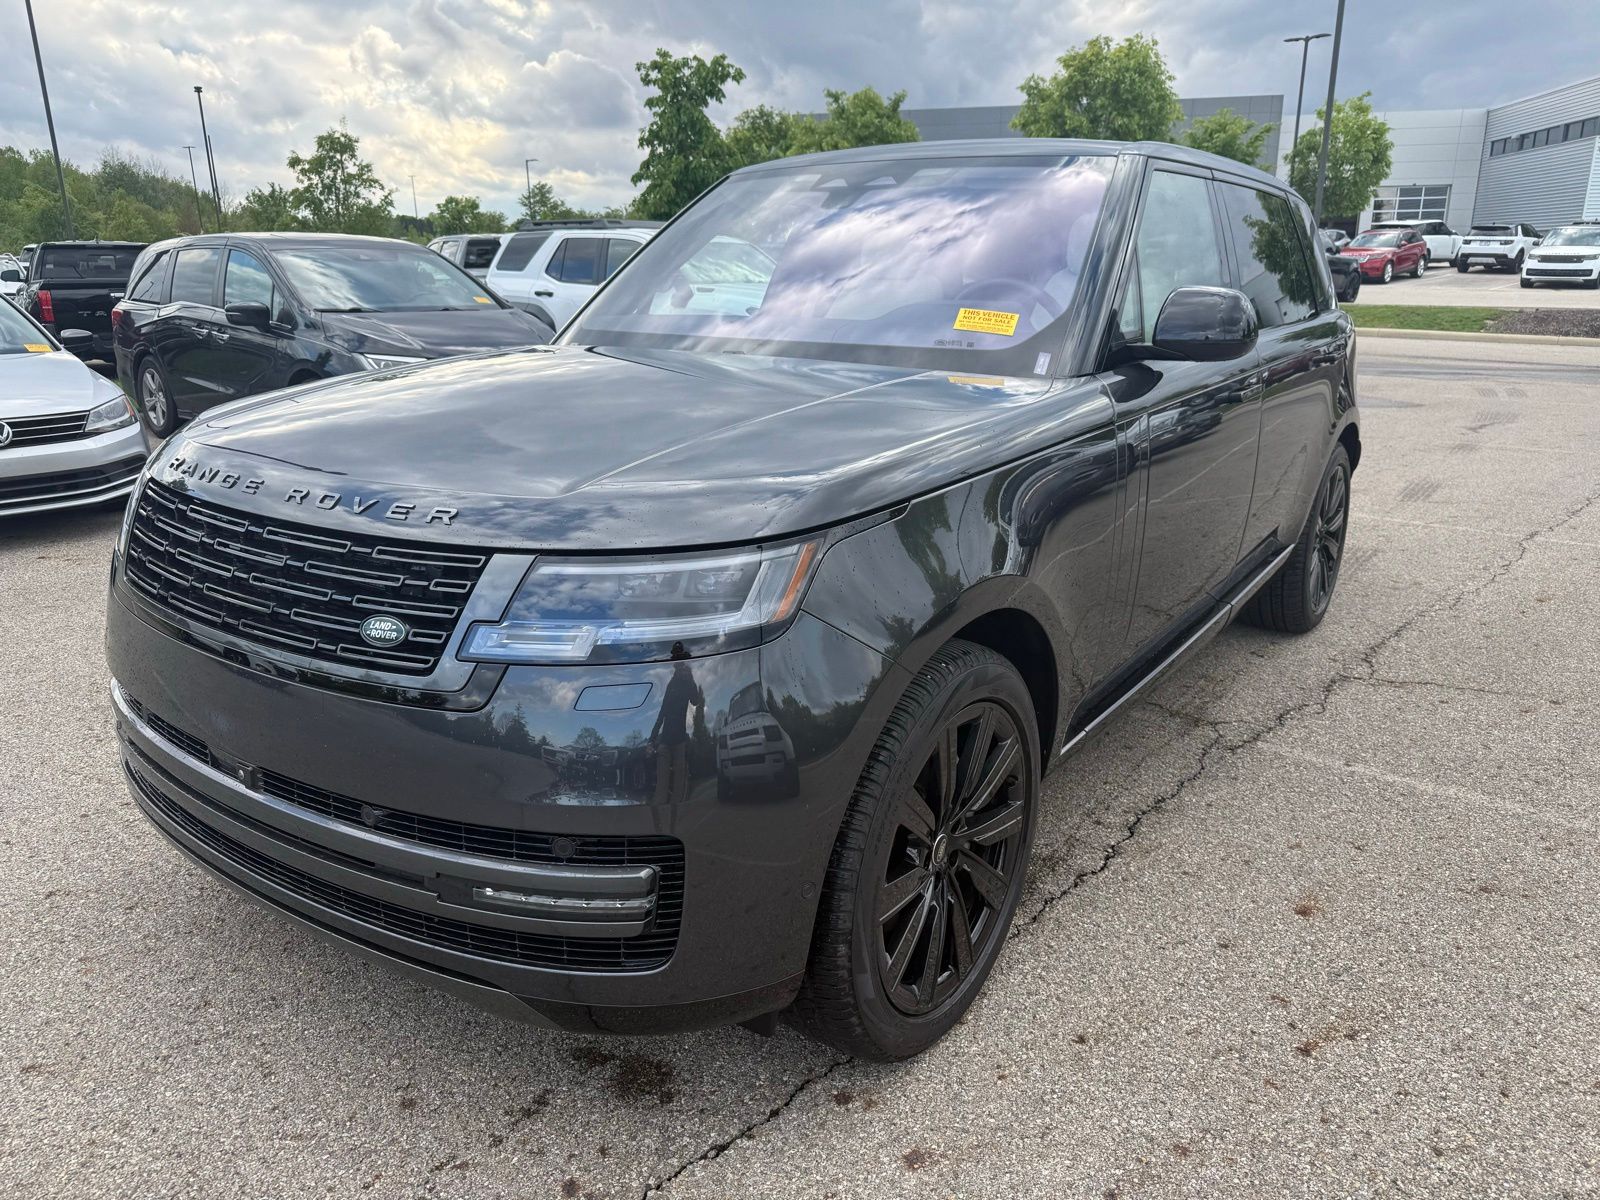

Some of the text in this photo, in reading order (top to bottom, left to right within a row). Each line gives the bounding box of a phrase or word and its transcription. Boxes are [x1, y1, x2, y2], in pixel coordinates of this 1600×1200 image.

[963, 309, 1016, 320] THIS VEHICLE
[167, 456, 459, 526] RANGE ROVER
[369, 620, 392, 631] LAND
[370, 629, 398, 640] ROVER
